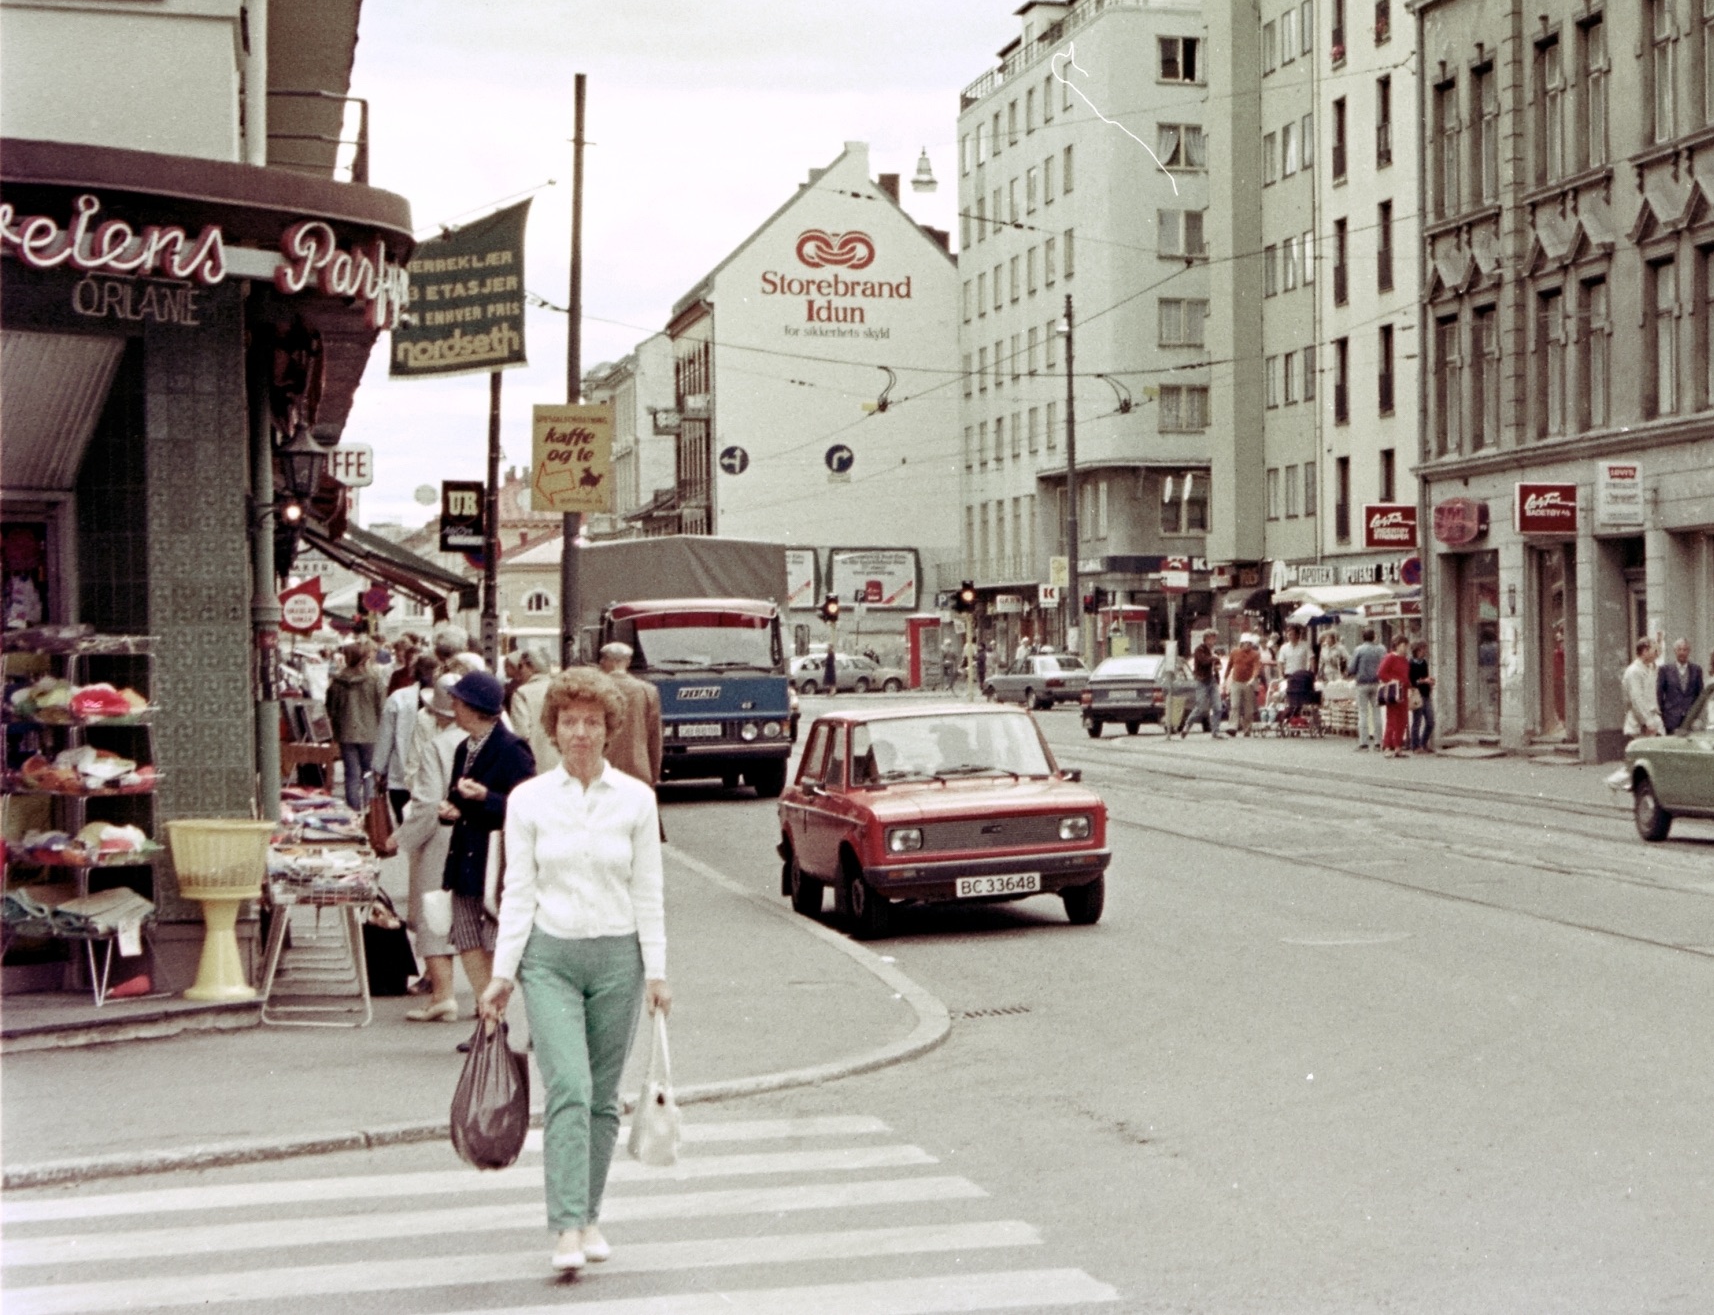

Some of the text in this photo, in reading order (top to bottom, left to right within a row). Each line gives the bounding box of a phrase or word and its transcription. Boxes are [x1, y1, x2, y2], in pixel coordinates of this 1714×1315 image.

[426, 275, 518, 300] ETASJER
[761, 270, 912, 299] Storebrand
[72, 272, 201, 326] ORLANE
[487, 302, 520, 318] PRIS
[806, 299, 865, 324] Idun
[397, 322, 520, 367] nordseth
[785, 325, 891, 341] for sikkerhets skyld
[545, 426, 596, 446] kaffe
[333, 451, 367, 478] FFE
[547, 447, 594, 465] og te
[448, 491, 478, 516] UR
[1301, 567, 1331, 582] APOTEK
[961, 875, 1036, 895] BC 33648
